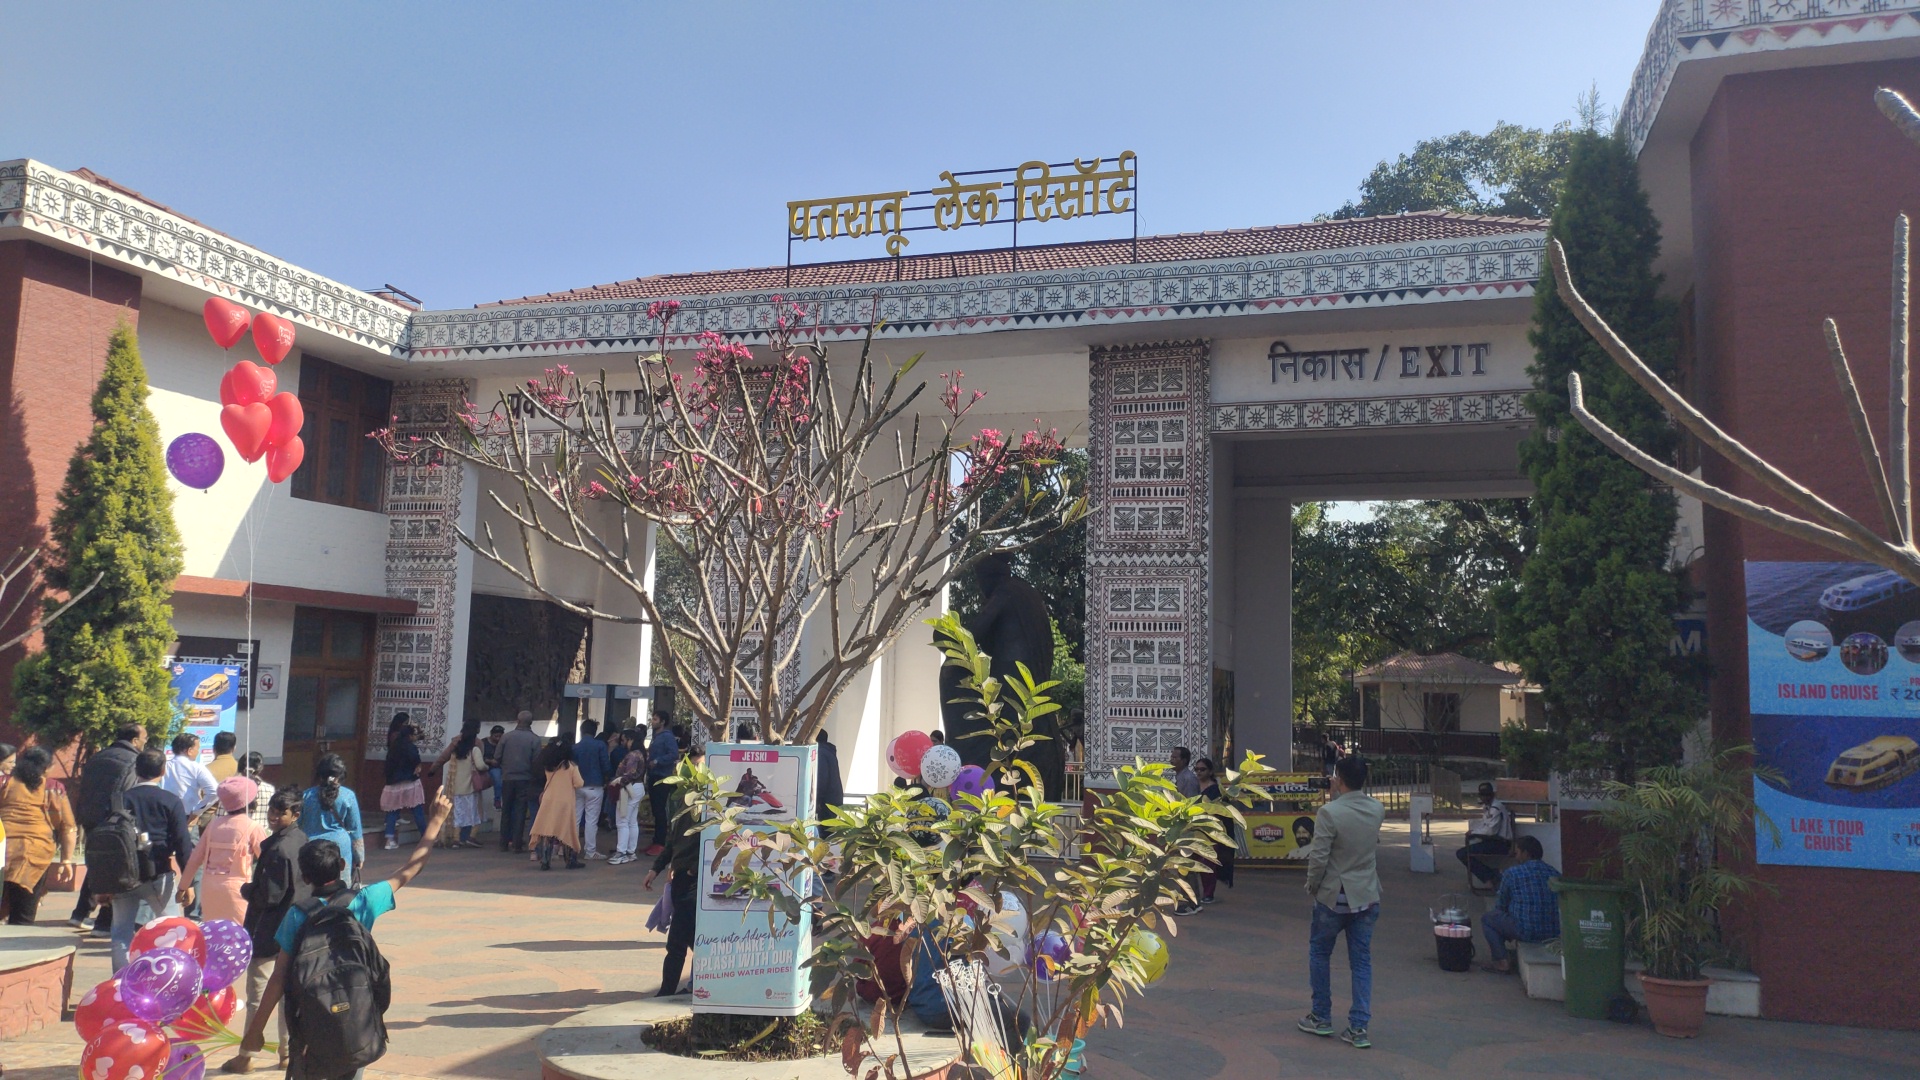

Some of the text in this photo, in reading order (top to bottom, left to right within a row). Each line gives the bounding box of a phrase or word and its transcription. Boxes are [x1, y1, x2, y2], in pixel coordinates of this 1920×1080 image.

[787, 150, 1136, 256] पतरातू लेक रिसॉर्ट
[1267, 341, 1370, 384] निकास
[1399, 343, 1490, 378] EXIT
[577, 389, 669, 417] ENTR
[1778, 683, 1879, 700] ISLAND CRUISE
[741, 751, 768, 762] JETSKI
[1791, 817, 1864, 836] LAKE TOUR
[1804, 835, 1852, 852] CRUISE
[710, 935, 776, 957] AND MAKE A
[721, 931, 740, 944] into
[694, 948, 794, 972] SPLASH WITH OUR
[694, 966, 792, 980] THRILLING WATER RIDES!
